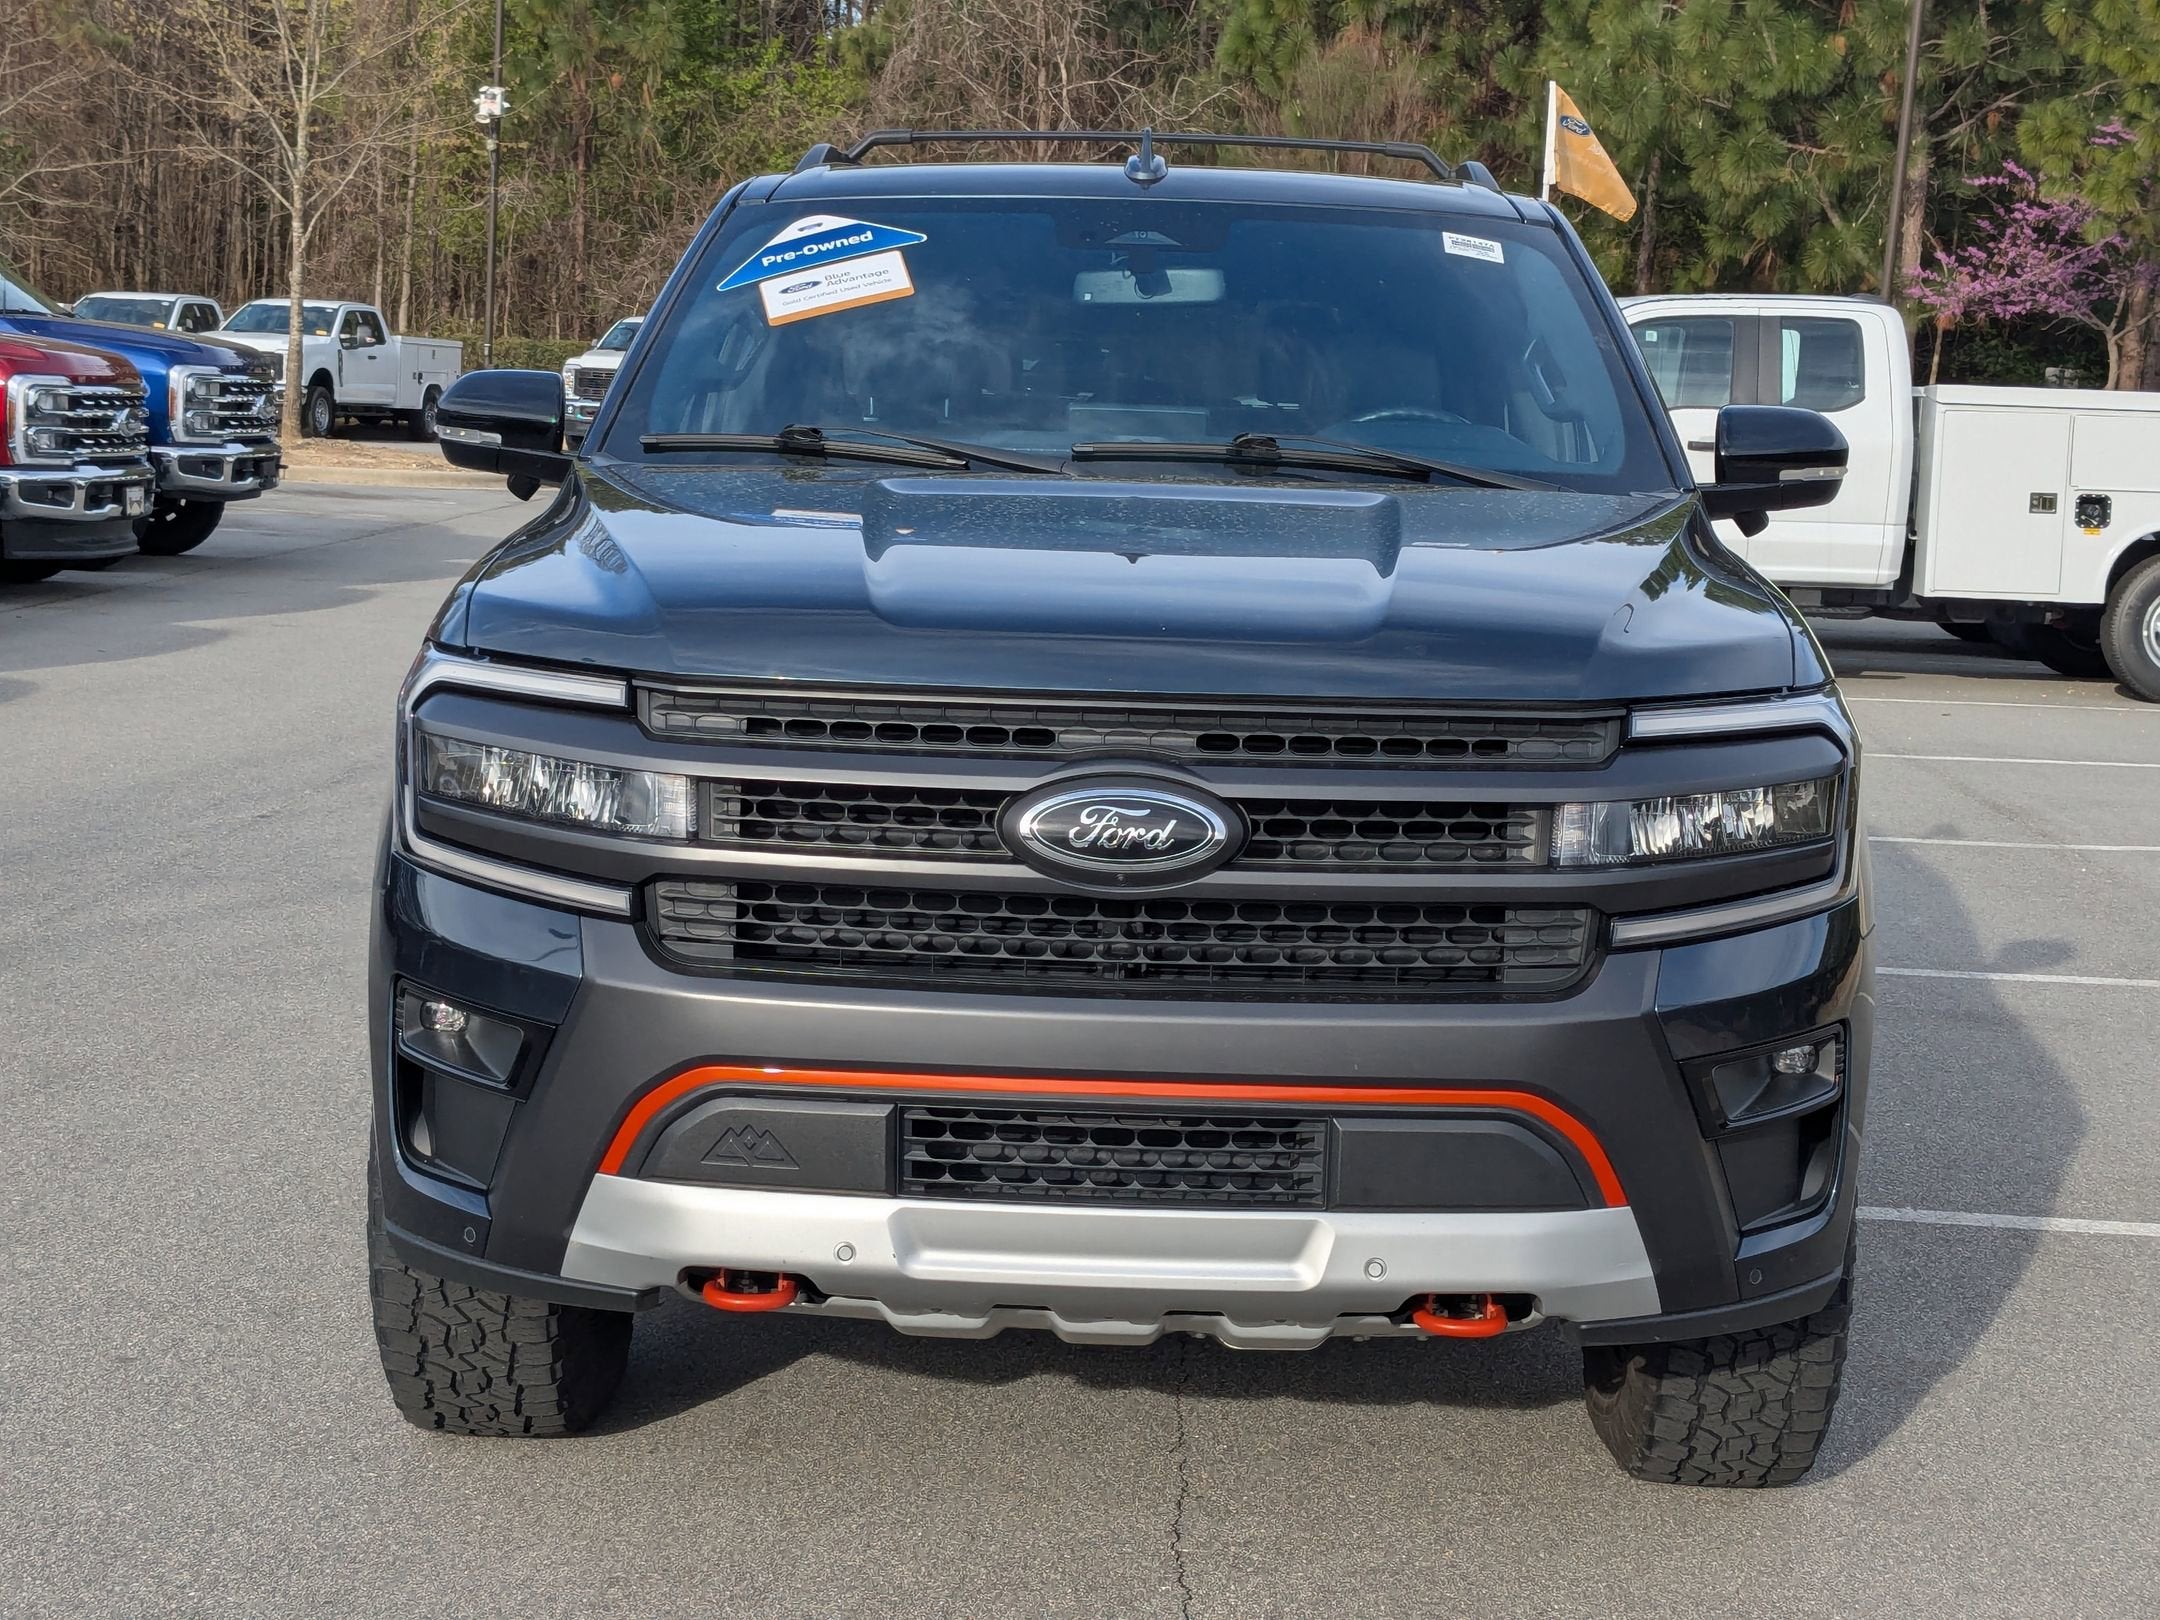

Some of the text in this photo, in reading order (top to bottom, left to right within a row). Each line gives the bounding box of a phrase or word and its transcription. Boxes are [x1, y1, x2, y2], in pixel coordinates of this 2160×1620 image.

[1562, 117, 1588, 135] Ford
[762, 230, 873, 267] Pre-Owned
[825, 270, 851, 282] Blue
[827, 269, 889, 286] Advantage
[803, 290, 838, 302] Certified
[863, 277, 892, 288] Vehicle
[1068, 804, 1178, 851] Ford
